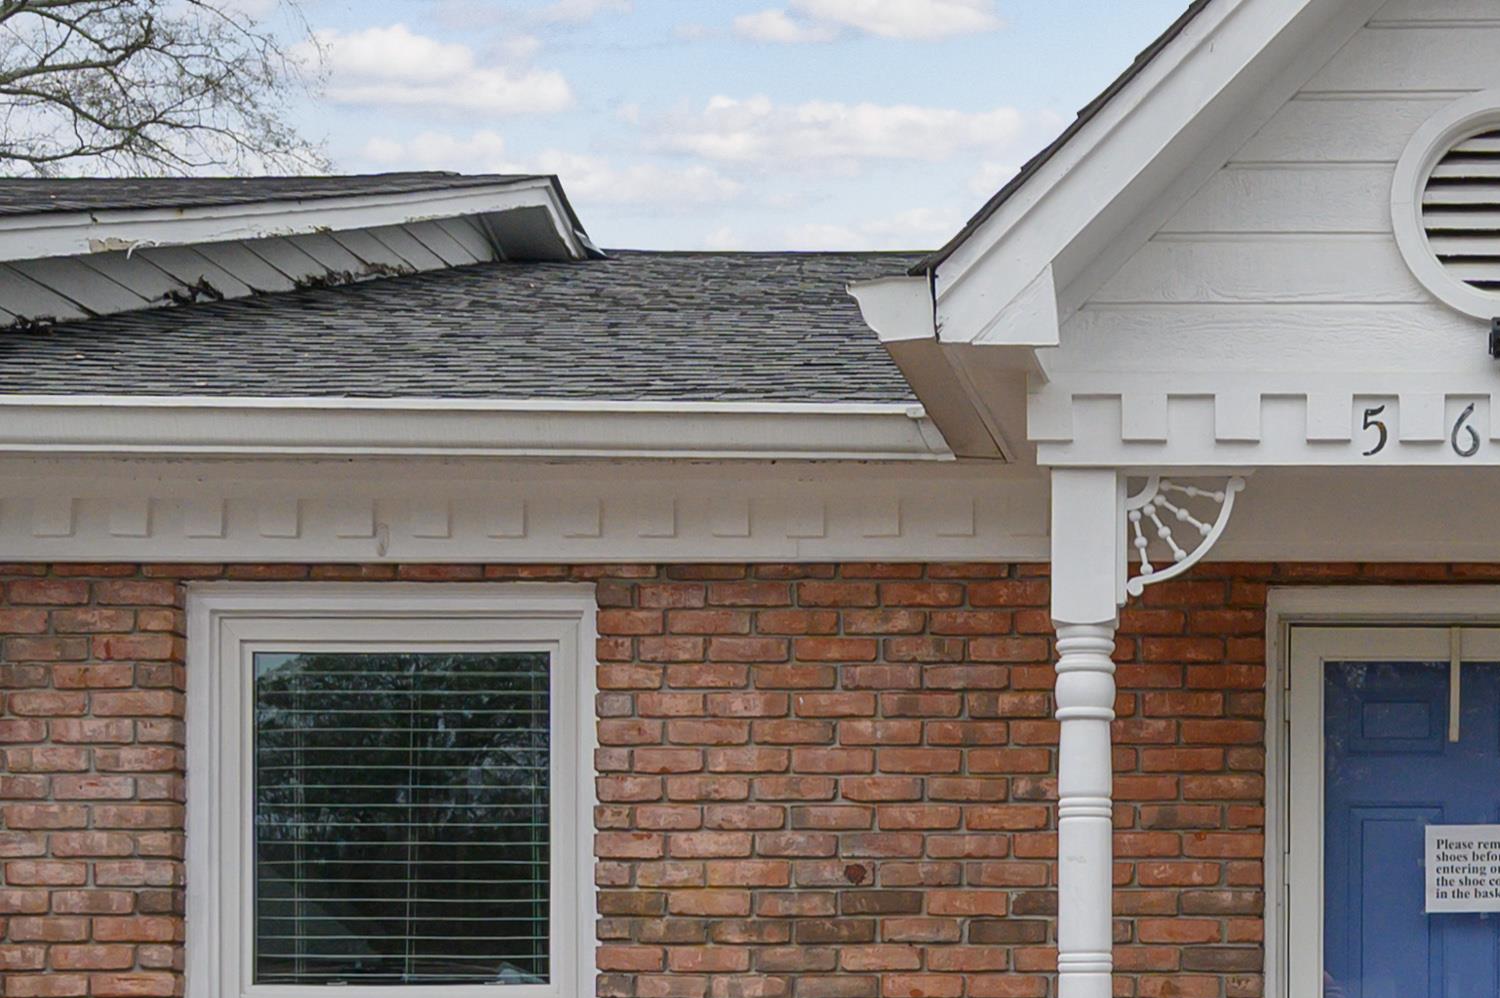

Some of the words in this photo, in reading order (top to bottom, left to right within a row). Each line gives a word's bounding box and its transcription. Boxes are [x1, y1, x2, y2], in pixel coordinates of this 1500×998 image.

[1436, 839, 1474, 850] Please
[1436, 852, 1468, 862] shoes
[1436, 864, 1487, 876] entering
[1436, 876, 1456, 887] the
[1459, 876, 1486, 886] shoe
[1436, 888, 1448, 899] in
[1452, 888, 1470, 899] the
